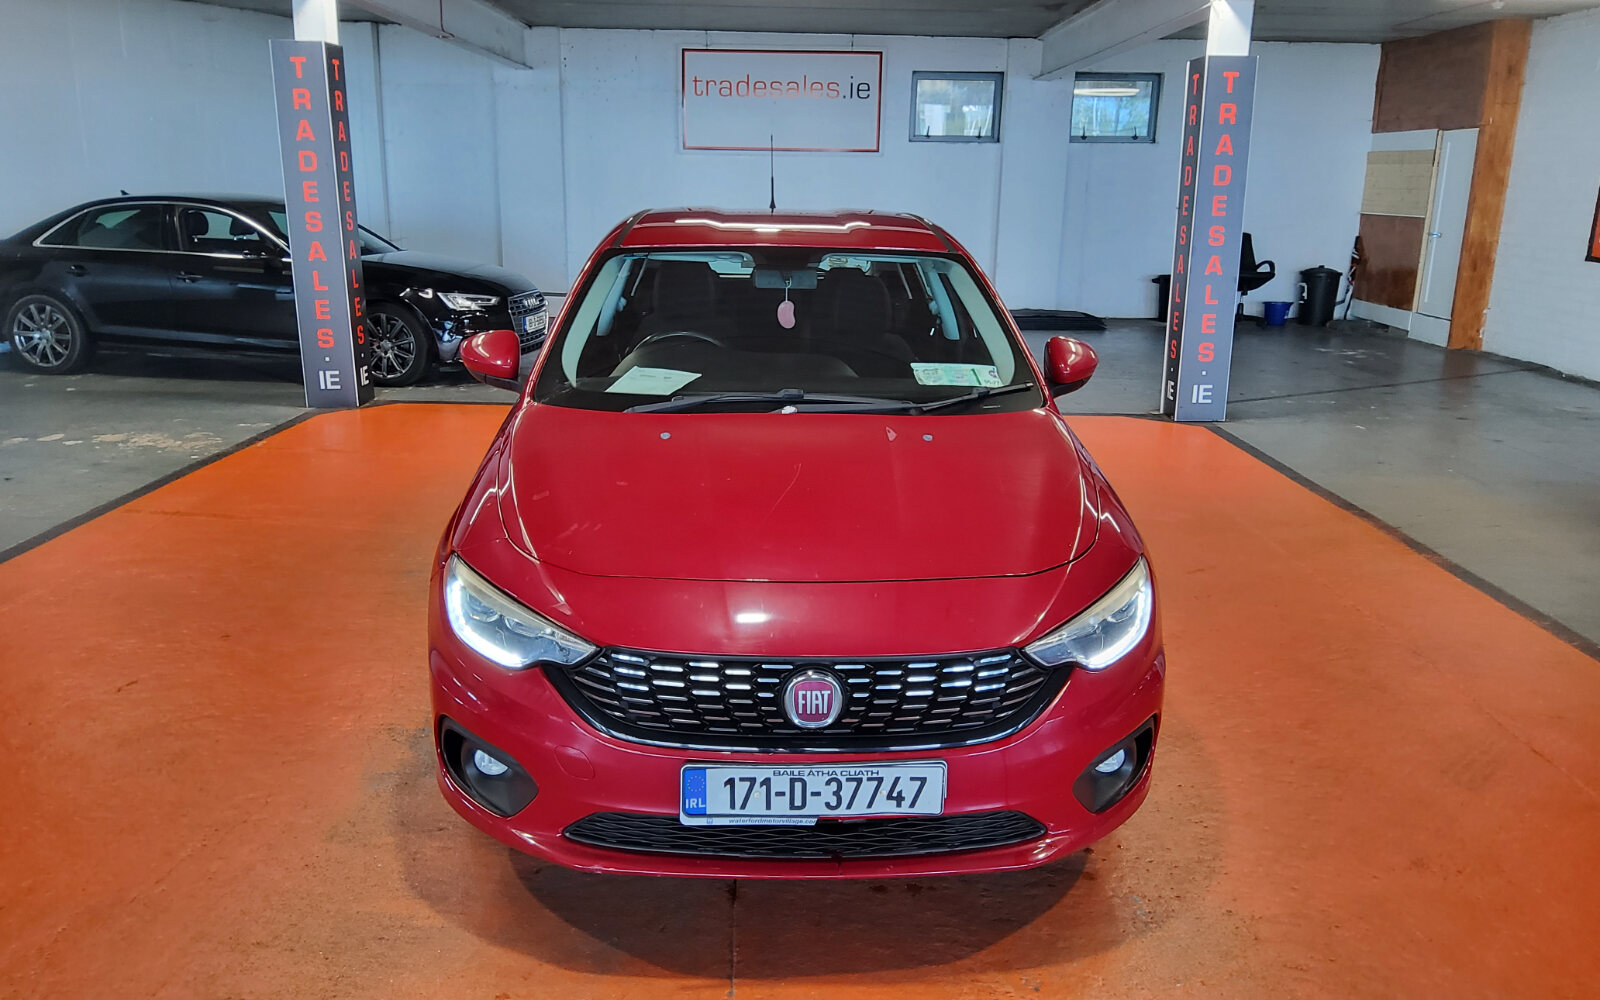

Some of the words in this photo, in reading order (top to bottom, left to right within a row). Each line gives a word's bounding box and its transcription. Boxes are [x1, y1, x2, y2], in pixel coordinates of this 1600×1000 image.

[693, 73, 871, 100] tradesales.ie
[798, 690, 831, 714] FIAT
[772, 769, 806, 777] BAILE
[685, 798, 706, 809] IRL
[723, 776, 928, 811] 171-D-37747
